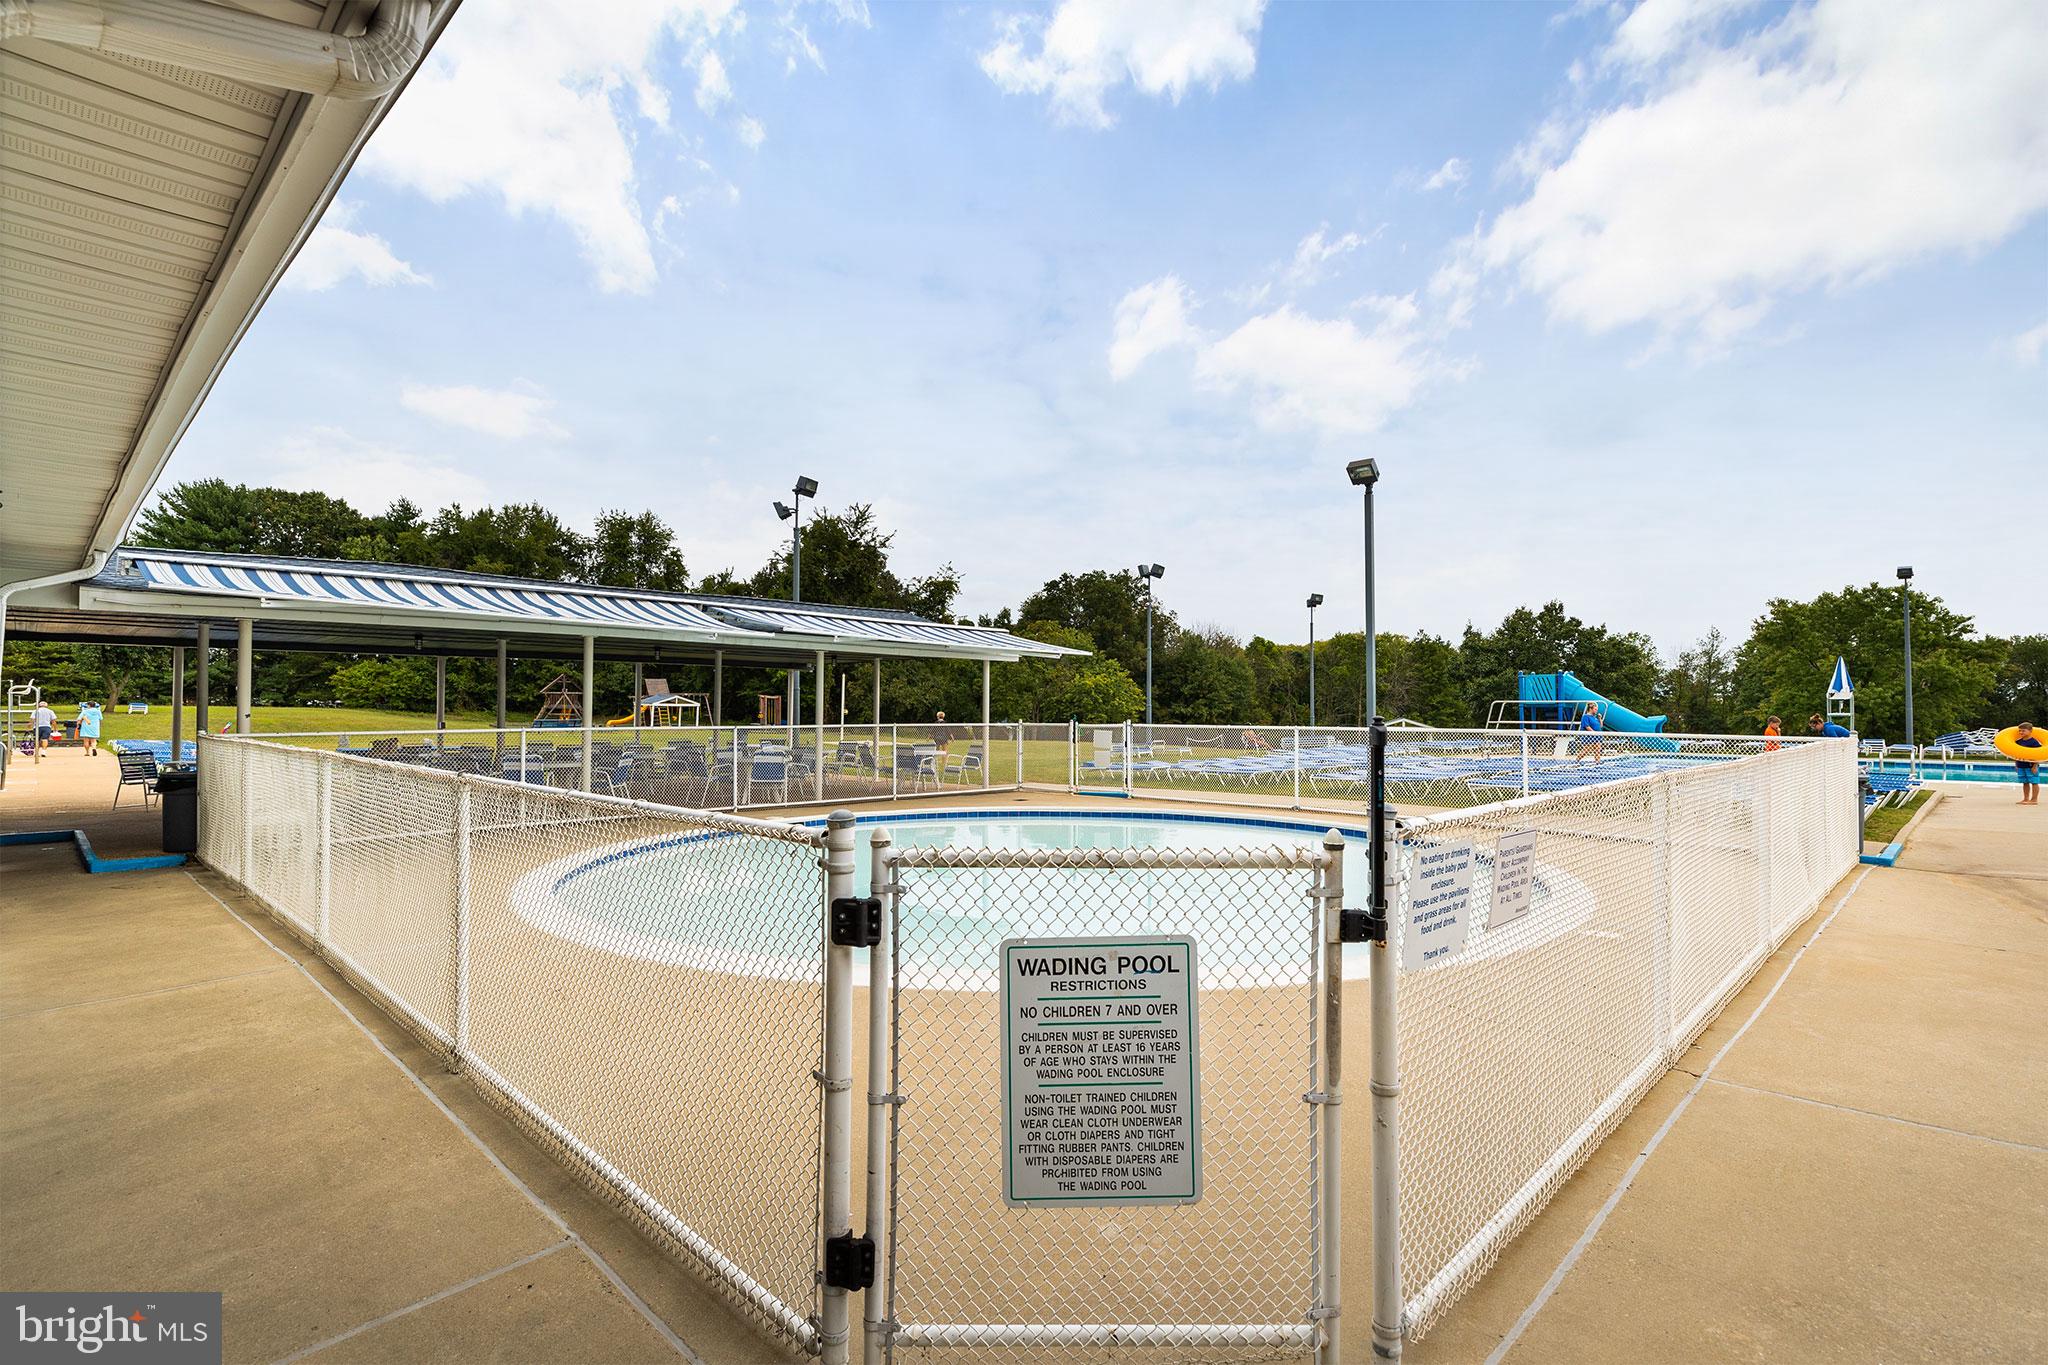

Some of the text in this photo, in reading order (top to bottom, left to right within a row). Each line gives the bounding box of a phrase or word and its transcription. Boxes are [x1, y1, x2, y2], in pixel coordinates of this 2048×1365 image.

[1420, 847, 1470, 865] No eating or drinking
[1420, 860, 1468, 880] inside the baby pool
[1431, 878, 1455, 891] enclosure.
[1412, 886, 1470, 910] Please use the pavilions
[1413, 912, 1423, 924] and
[1424, 909, 1438, 922] grass
[1438, 904, 1452, 915] areas
[1452, 902, 1460, 911] for
[1420, 916, 1457, 935] food and drink.
[1423, 945, 1450, 961] Thank you.
[1017, 955, 1180, 977] WADING POOL
[1050, 979, 1147, 992] RESTRICTIONS
[1020, 1004, 1178, 1019] NO CHILDREN 7 AND OVER
[1021, 1029, 1178, 1042] CHILDREN MUST BE SUPERVISED
[1019, 1042, 1181, 1055] BY A PERSON AT LEAST 16 YEARS
[1023, 1054, 1177, 1067] OF AGE WHO STAYS WITHIN THE
[1036, 1067, 1164, 1079] WADING POOL ENCLOSURE
[1024, 1091, 1177, 1104] NON-TOILET TRAINED CHILDREN
[1024, 1104, 1177, 1117] USING THE WADING POOL MUST
[1020, 1116, 1182, 1129] WEAR CLEAN CLOTH UNDERWEAR
[1027, 1129, 1175, 1142] OR CLOTH DIAPERS AND TIGHT
[1018, 1141, 1185, 1154] FITTING RUBBER PANTS. CHILDREN
[1025, 1153, 1179, 1166] WITH DISPOSABLE DIAPERS ARE
[1101, 1167, 1129, 1178] FROM
[1132, 1166, 1162, 1177] USING
[1058, 1180, 1147, 1191] THE WADING POOL
